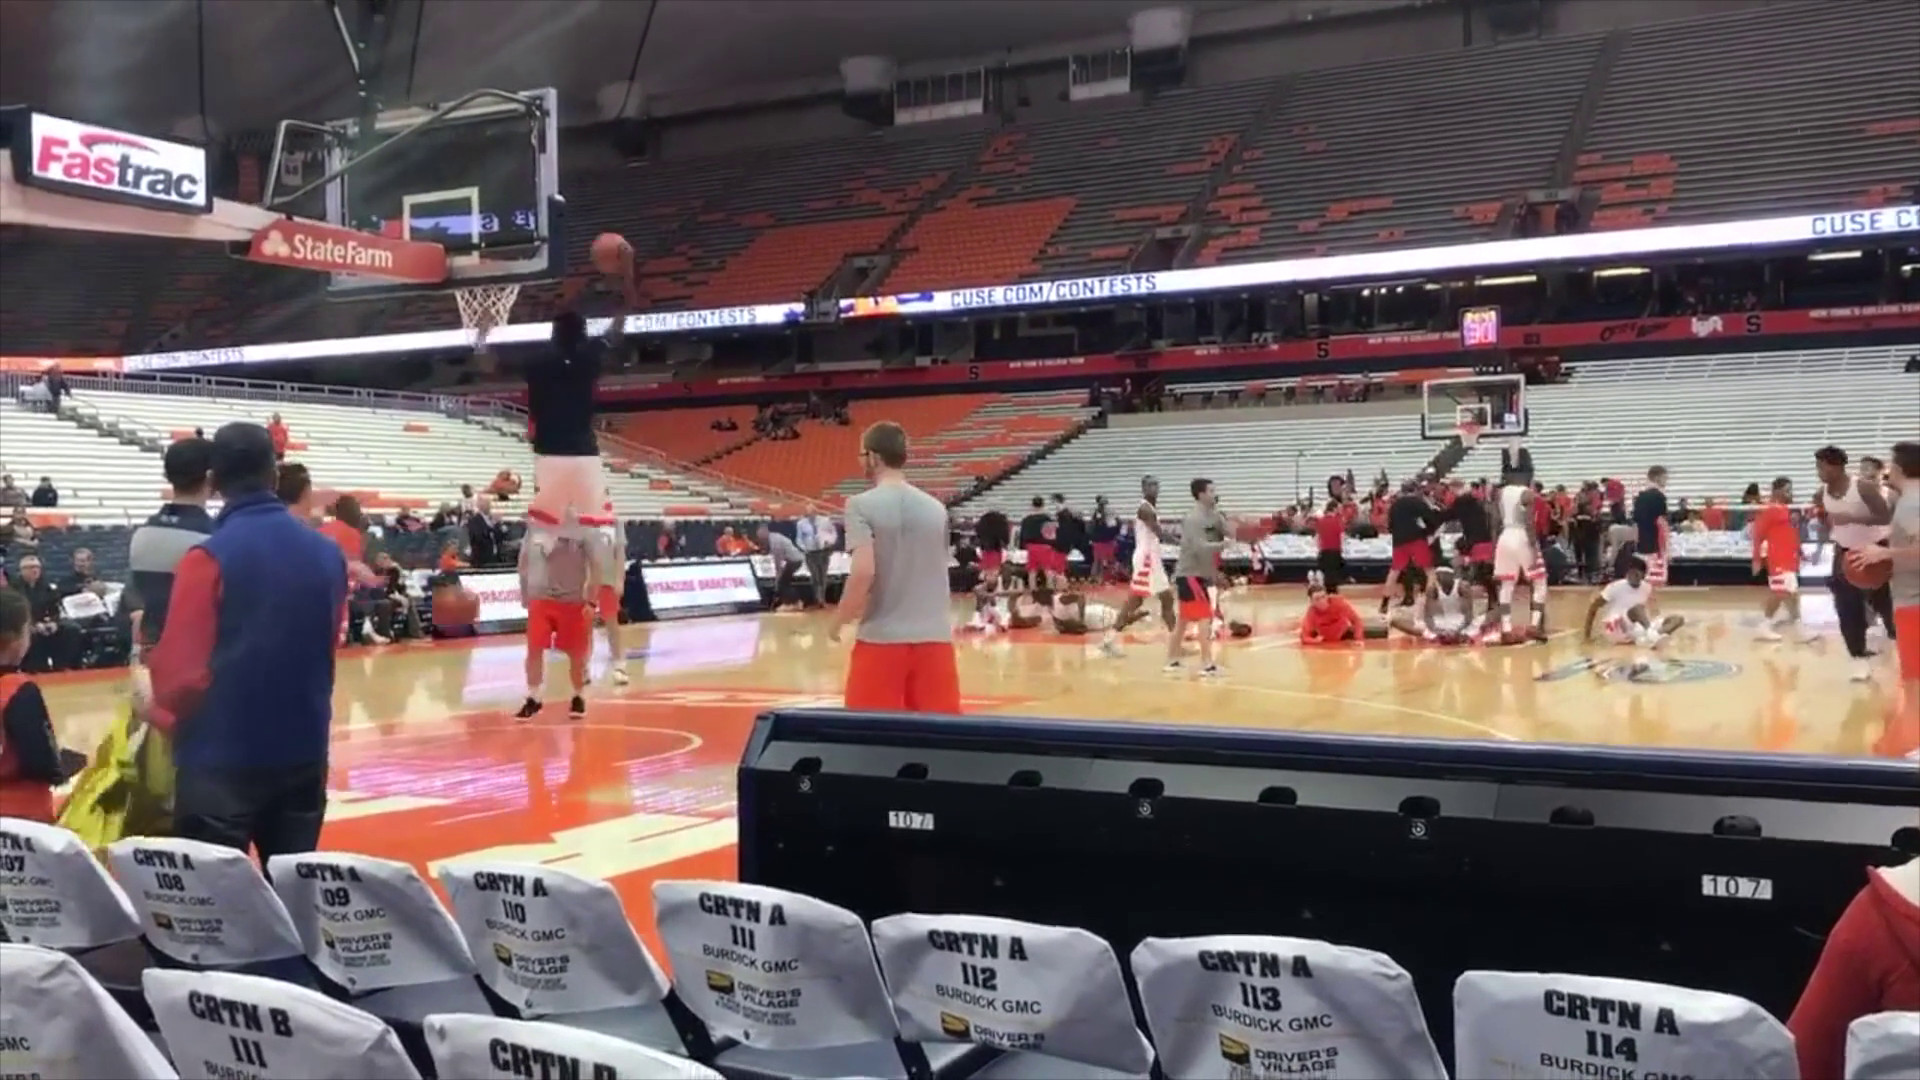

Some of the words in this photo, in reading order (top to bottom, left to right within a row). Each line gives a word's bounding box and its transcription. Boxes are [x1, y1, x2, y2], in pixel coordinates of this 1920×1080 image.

[37, 132, 198, 199] Fastrac
[1746, 314, 1761, 334] S
[1316, 340, 1330, 360] S
[969, 365, 980, 381] S
[895, 811, 926, 829] 107
[133, 847, 178, 869] CRTN
[181, 853, 196, 871] A
[154, 871, 186, 892] 108
[346, 866, 363, 883] A
[473, 870, 525, 897] CRTN
[532, 876, 549, 897] A
[1709, 875, 1762, 898] 107
[354, 907, 387, 921] GMC
[501, 898, 527, 924] 110
[698, 891, 761, 924] CRTN
[768, 903, 788, 926] A
[531, 927, 567, 942] GMC
[730, 923, 756, 952] 111
[927, 929, 999, 960] CRTN
[1008, 936, 1029, 962] A
[702, 943, 759, 972] BURDICK
[761, 958, 801, 974] GMC
[1198, 949, 1281, 978] CRTN
[1291, 954, 1314, 979] A
[737, 980, 802, 1000] DRIVER'S
[961, 961, 998, 992] 112
[740, 991, 800, 1010] VILLAGE
[935, 984, 999, 1012] BURDICK
[1001, 999, 1043, 1015] GMC
[1239, 981, 1283, 1012] 113
[187, 989, 264, 1034] CRTN
[268, 1007, 294, 1038] B
[1211, 1003, 1285, 1033] BURDICK
[1288, 1013, 1333, 1033] GMC
[1543, 988, 1643, 1032] CRTN
[1653, 1006, 1681, 1037] A
[973, 1024, 1046, 1043] DRIVER'S
[1585, 1029, 1639, 1063] 114
[228, 1034, 268, 1070] 111
[489, 1038, 580, 1080] CRTN
[1254, 1046, 1339, 1062] DRIVER'S
[1260, 1058, 1336, 1074] VILLAGE
[1540, 1052, 1637, 1080] BURDICK
